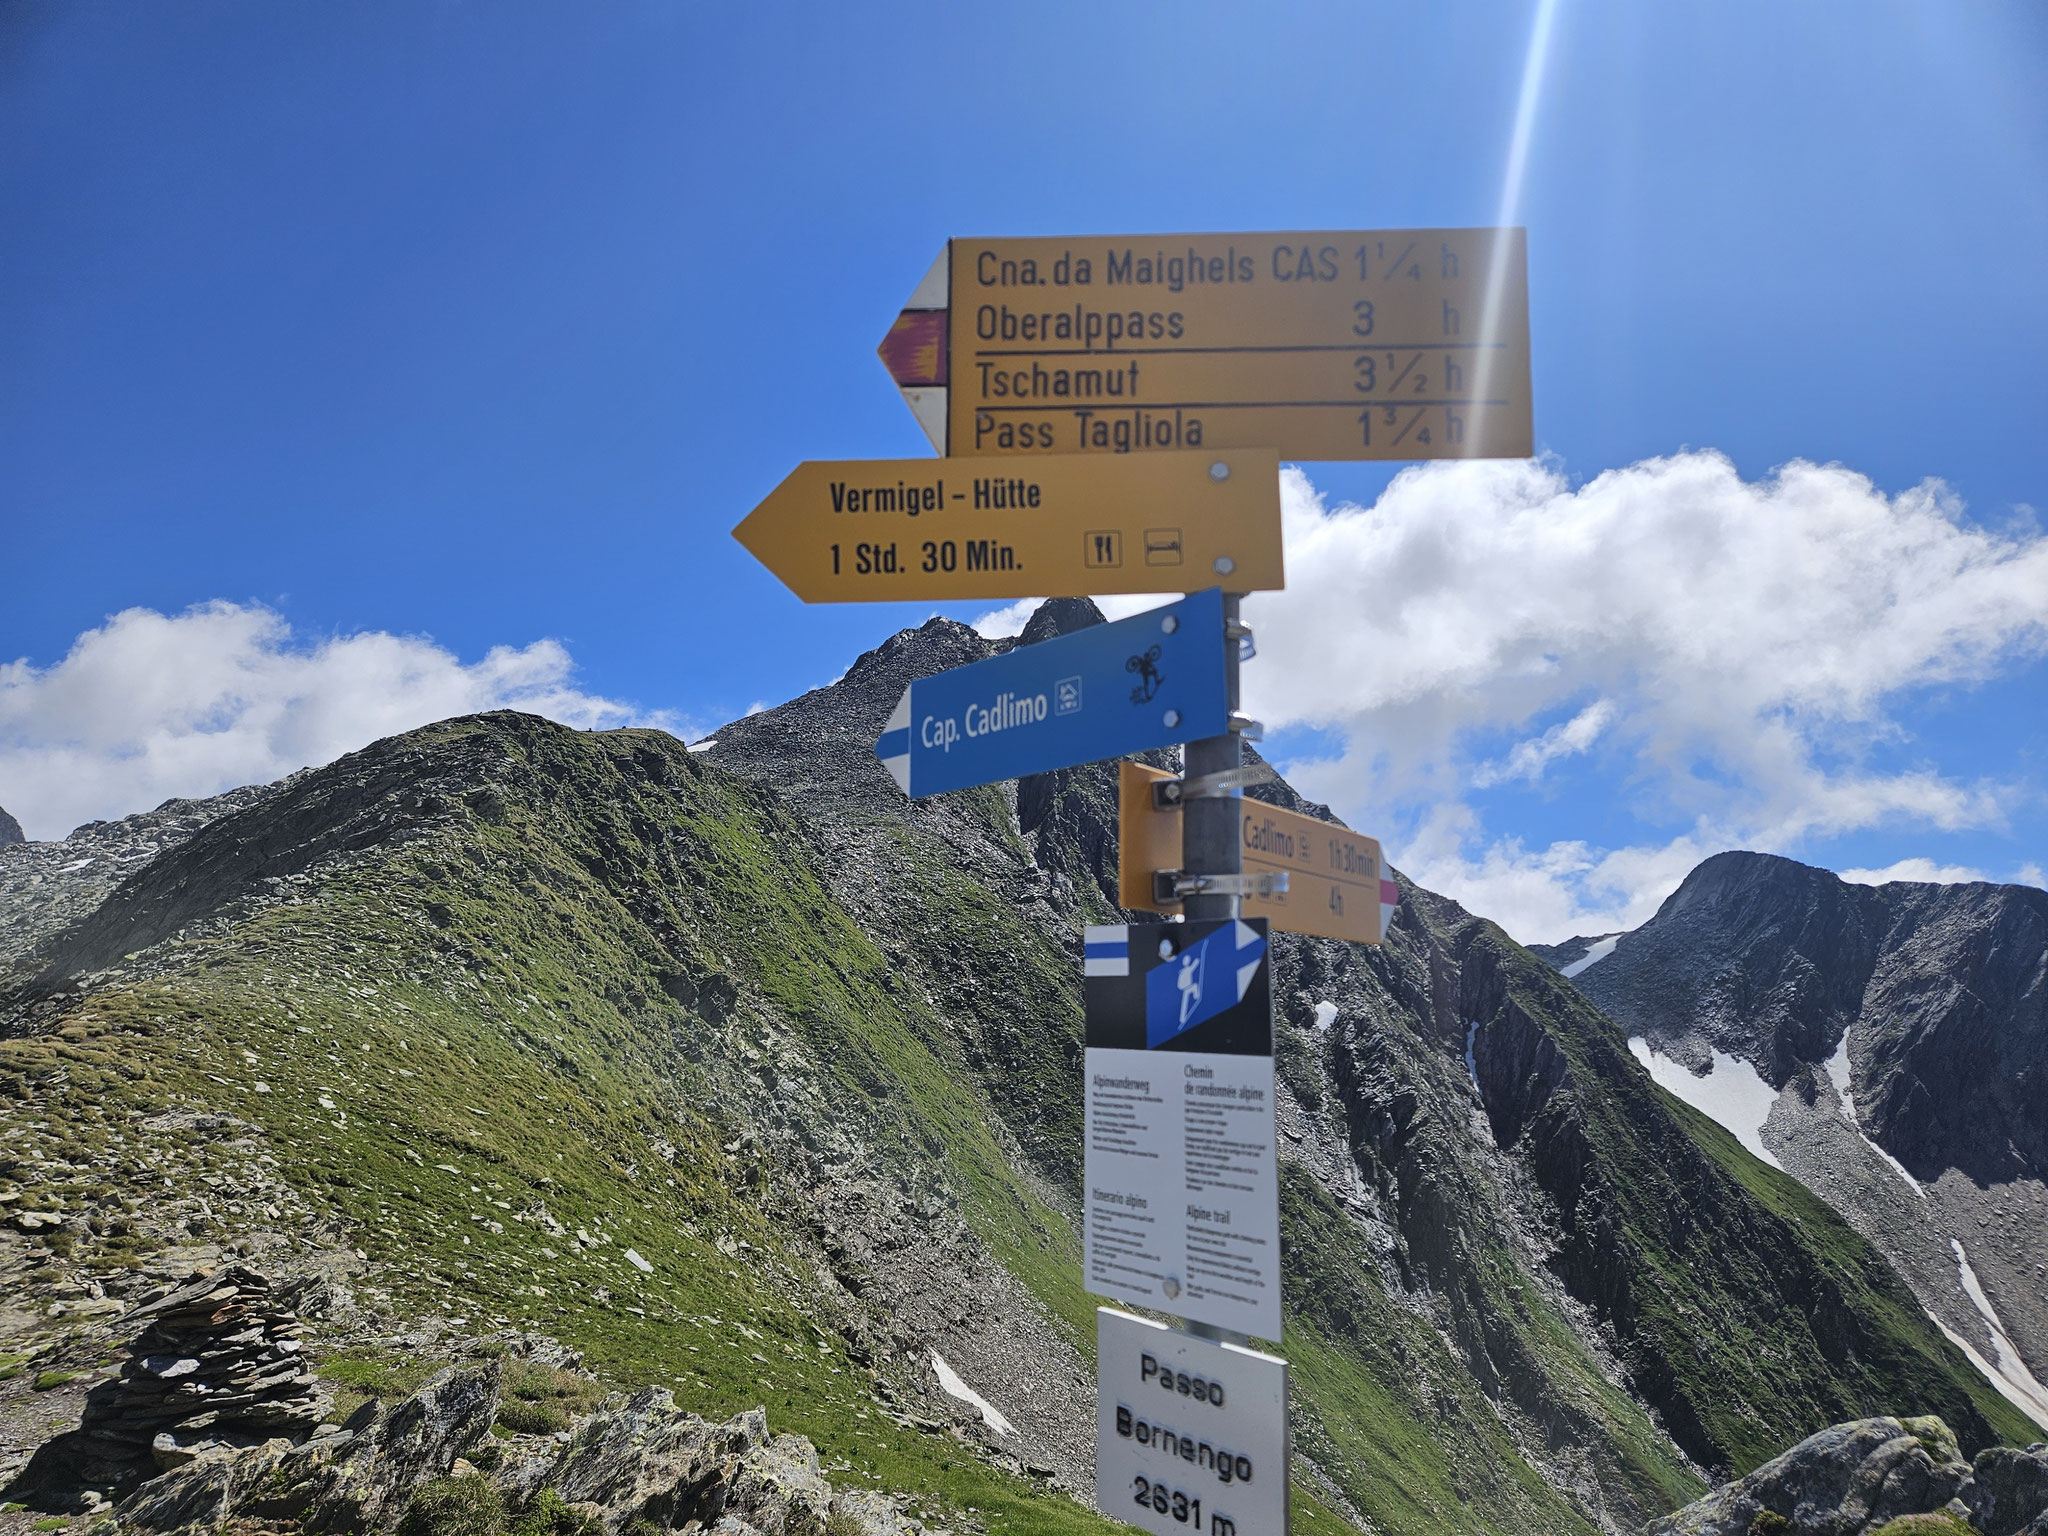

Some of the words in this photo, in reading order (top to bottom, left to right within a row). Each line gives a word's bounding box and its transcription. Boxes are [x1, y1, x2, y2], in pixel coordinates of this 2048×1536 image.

[1107, 247, 1255, 293] Maighels
[1272, 245, 1338, 282] CAS
[1441, 243, 1459, 280] h
[976, 303, 1184, 349] Oberalppass
[1353, 300, 1375, 336] 3
[1442, 299, 1461, 336] h
[976, 360, 1139, 398] Tschamut
[1445, 354, 1462, 391] h
[976, 413, 1054, 449] Pass
[1074, 409, 1203, 454] Tagliola
[1446, 407, 1463, 444] h
[830, 479, 944, 517] Vermigel
[974, 478, 1041, 510] Hütte
[830, 544, 840, 575] 1
[856, 542, 906, 574] Std.
[921, 540, 957, 573] 30
[966, 539, 1023, 572] Min.
[921, 715, 961, 753] Cap.
[965, 692, 1047, 738] Cadlimo
[1242, 815, 1295, 859] Cadlimo
[1140, 1352, 1225, 1408] Passo
[1133, 1475, 1201, 1531] 2631
